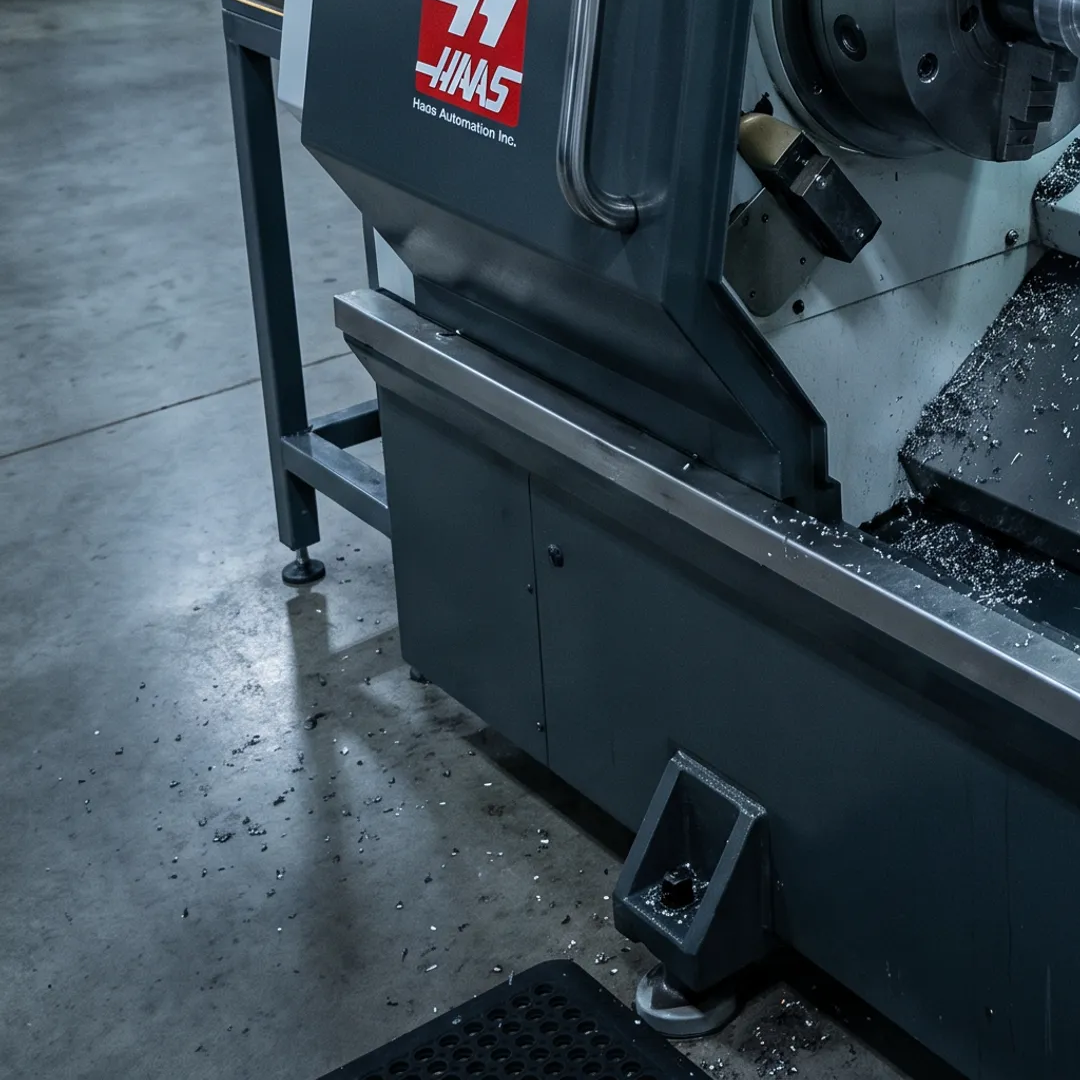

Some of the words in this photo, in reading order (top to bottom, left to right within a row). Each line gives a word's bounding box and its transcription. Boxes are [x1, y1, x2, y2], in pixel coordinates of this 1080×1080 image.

[415, 46, 523, 113] HAAS
[438, 108, 496, 140] Automation
[497, 129, 517, 148] Inc.
